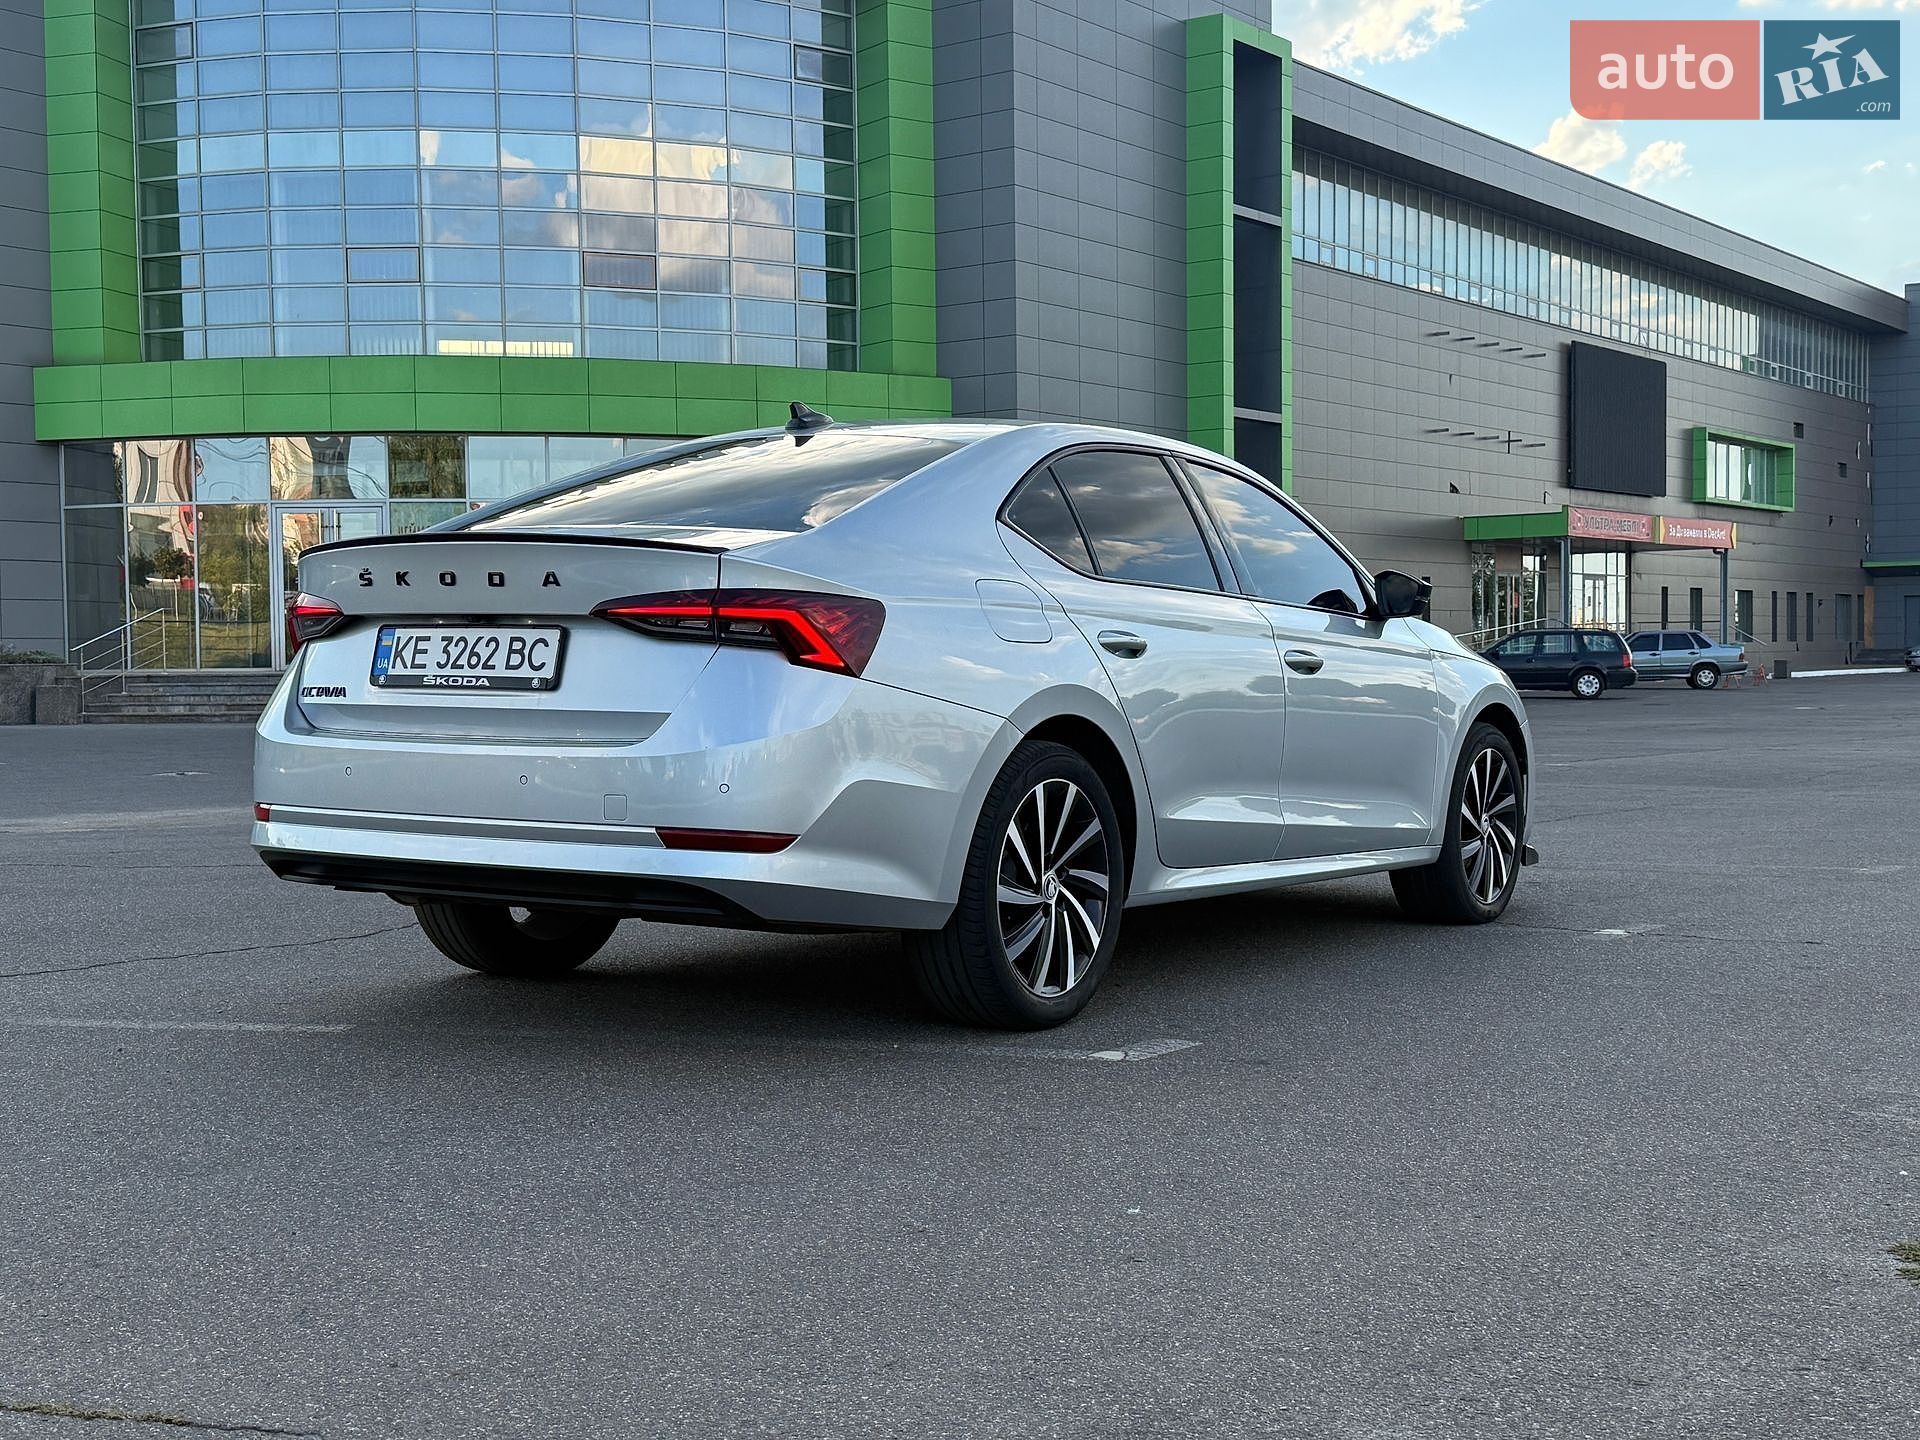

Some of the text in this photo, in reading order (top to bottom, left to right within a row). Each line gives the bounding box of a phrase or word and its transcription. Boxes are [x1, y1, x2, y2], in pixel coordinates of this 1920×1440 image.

[359, 567, 561, 588] ŠKODA
[392, 635, 550, 671] KE 3262 BC
[377, 658, 388, 669] UA
[423, 675, 490, 687] ŠKODA
